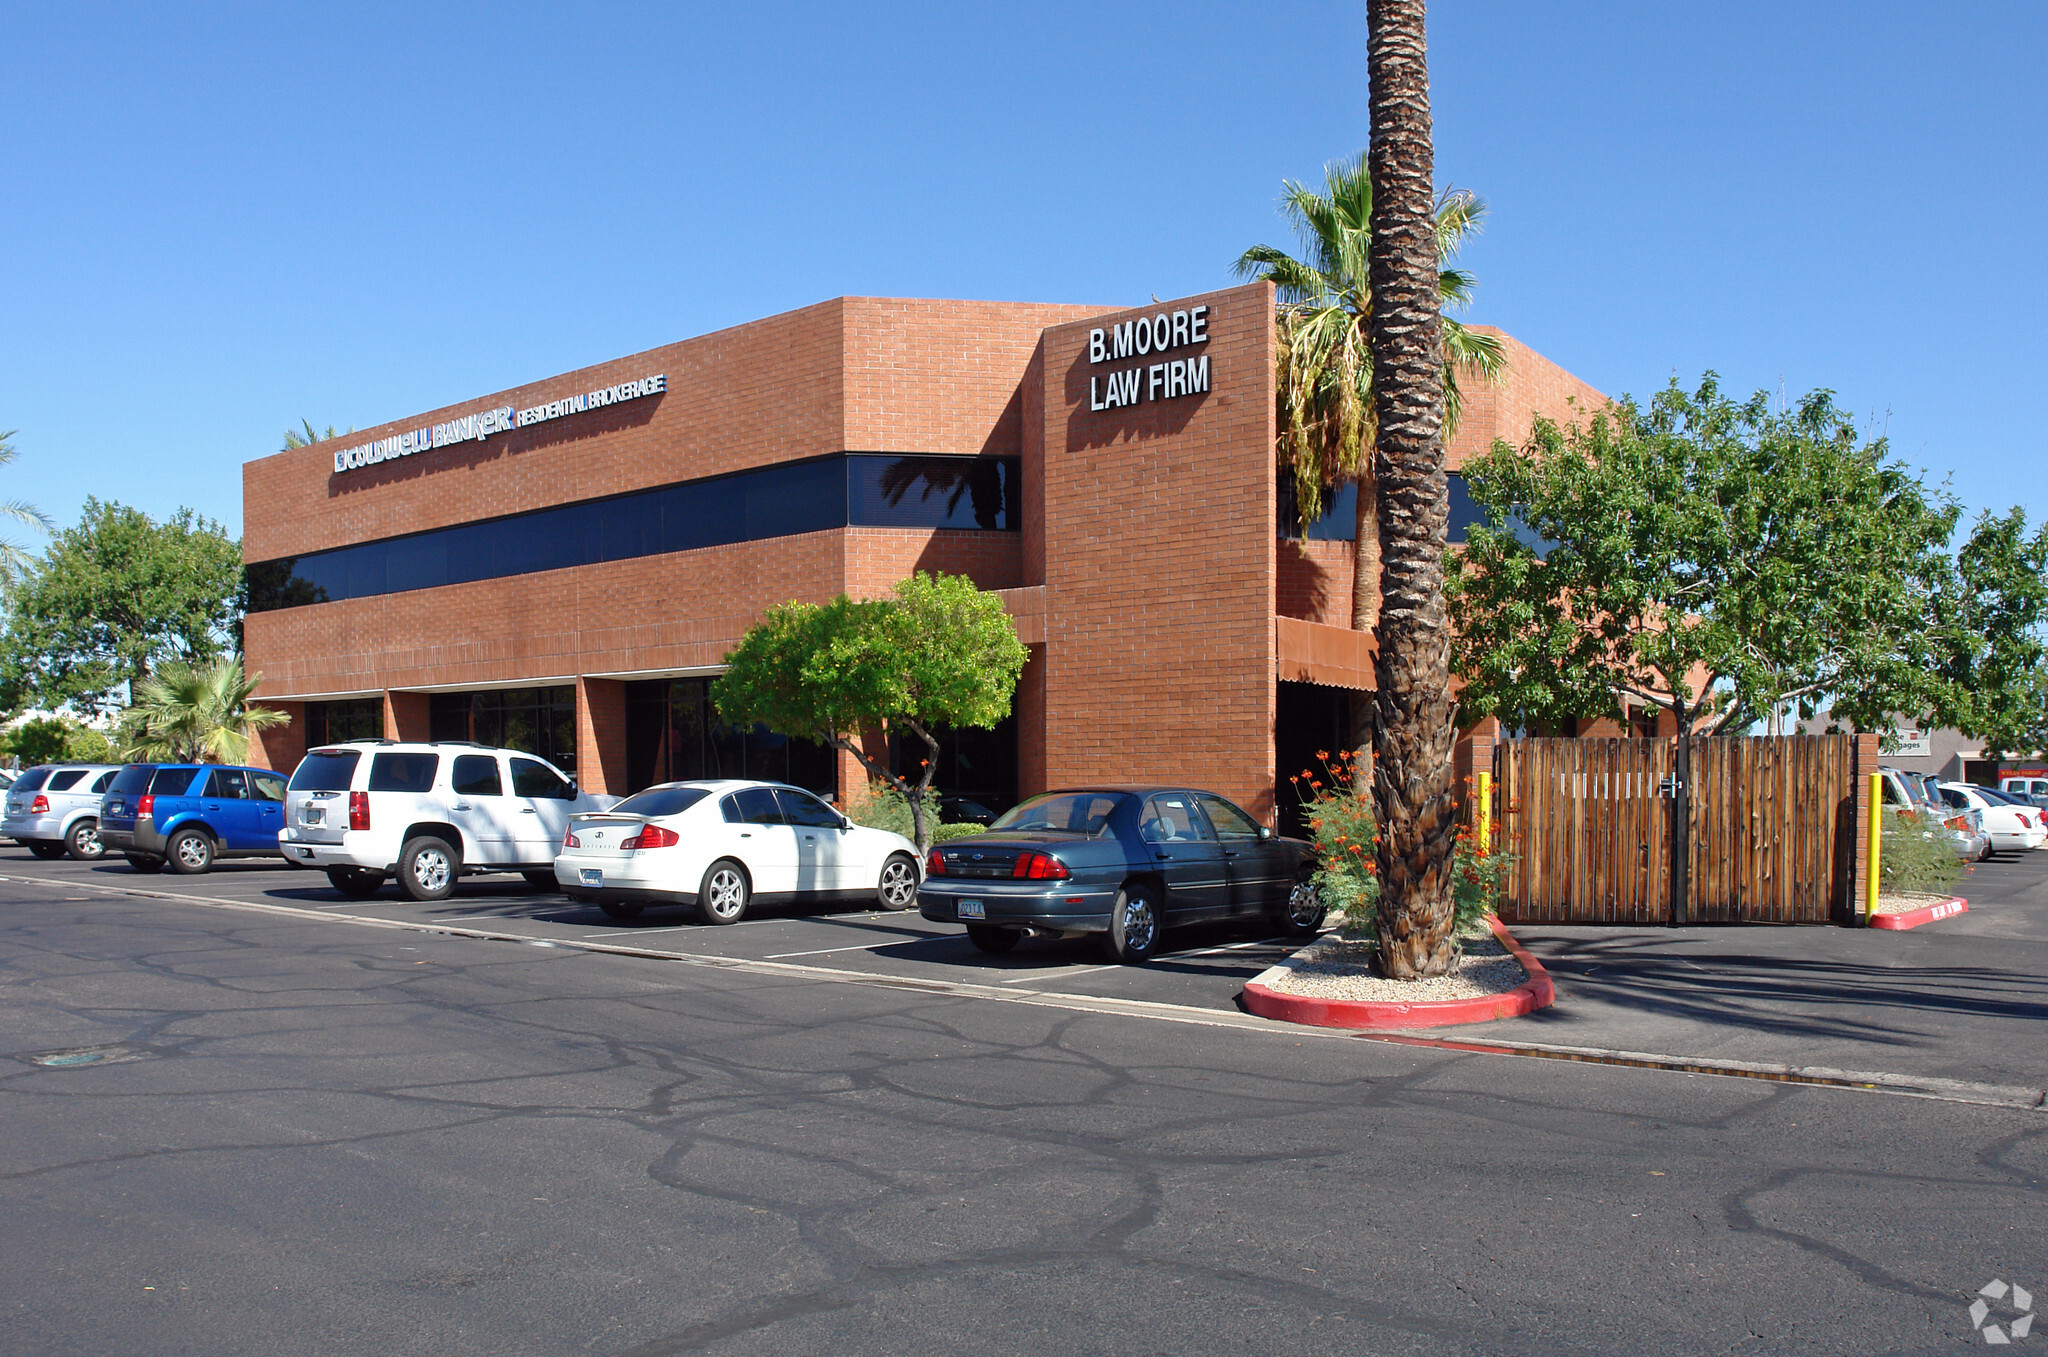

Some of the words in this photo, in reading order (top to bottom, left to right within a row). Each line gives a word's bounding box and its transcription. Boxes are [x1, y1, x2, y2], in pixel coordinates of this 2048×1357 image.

[1090, 305, 1208, 364] B.MOORE
[517, 394, 588, 427] RESIDENTIAL
[588, 373, 667, 409] BROKERAGE
[1091, 368, 1141, 411] LAW
[1149, 355, 1209, 401] FIRM
